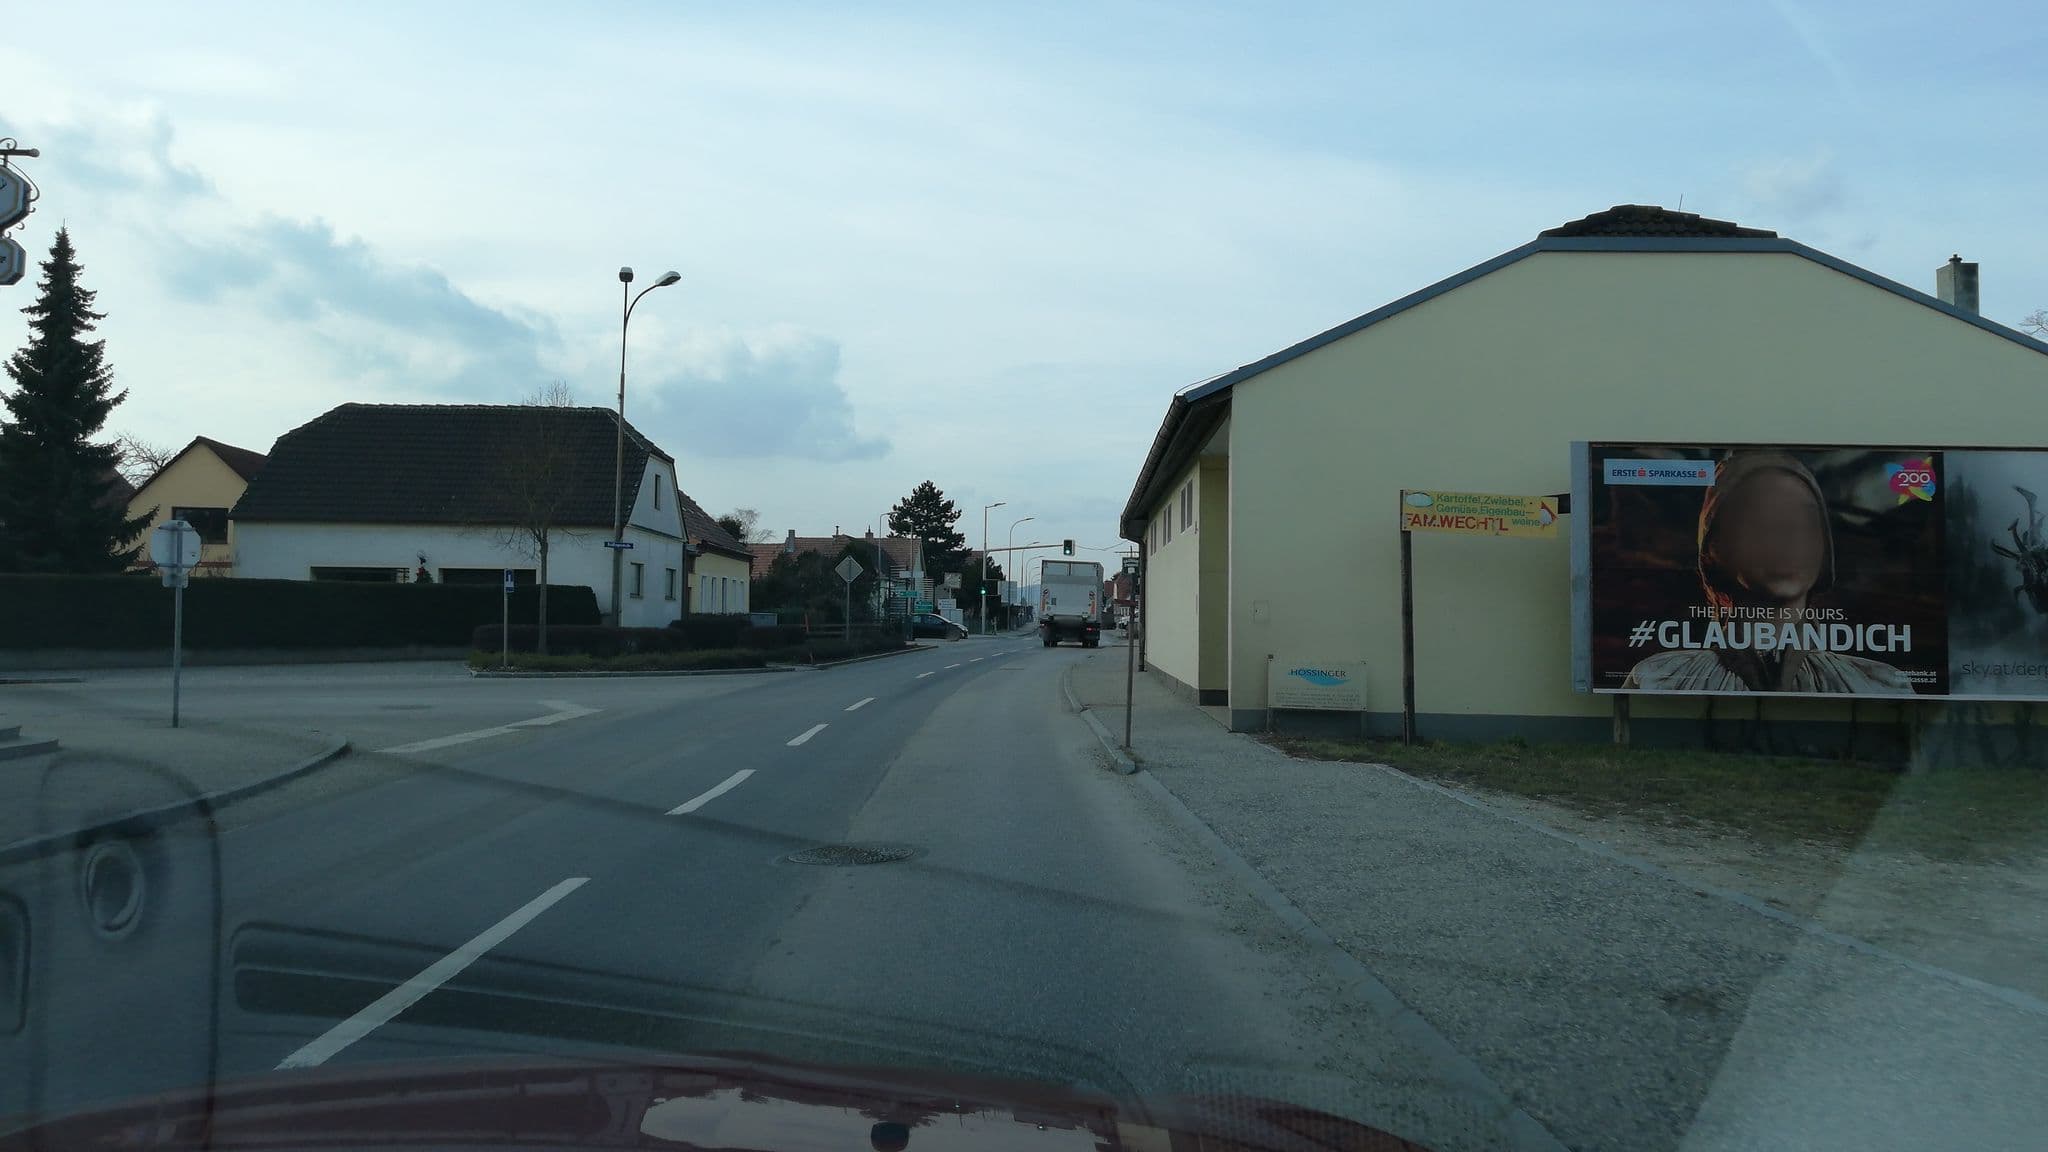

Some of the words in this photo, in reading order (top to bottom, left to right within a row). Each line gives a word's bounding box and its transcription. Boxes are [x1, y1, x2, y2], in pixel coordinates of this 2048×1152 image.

[1611, 469, 1638, 478] ERSTE
[1648, 469, 1698, 479] SPARKASSE
[1897, 472, 1931, 487] 200
[1688, 606, 1716, 618] THE
[1719, 606, 1776, 619] FUTURE
[1779, 607, 1793, 620] IS
[1795, 607, 1849, 621] YOURS.
[1628, 619, 1912, 653] #GLAUBANDICH
